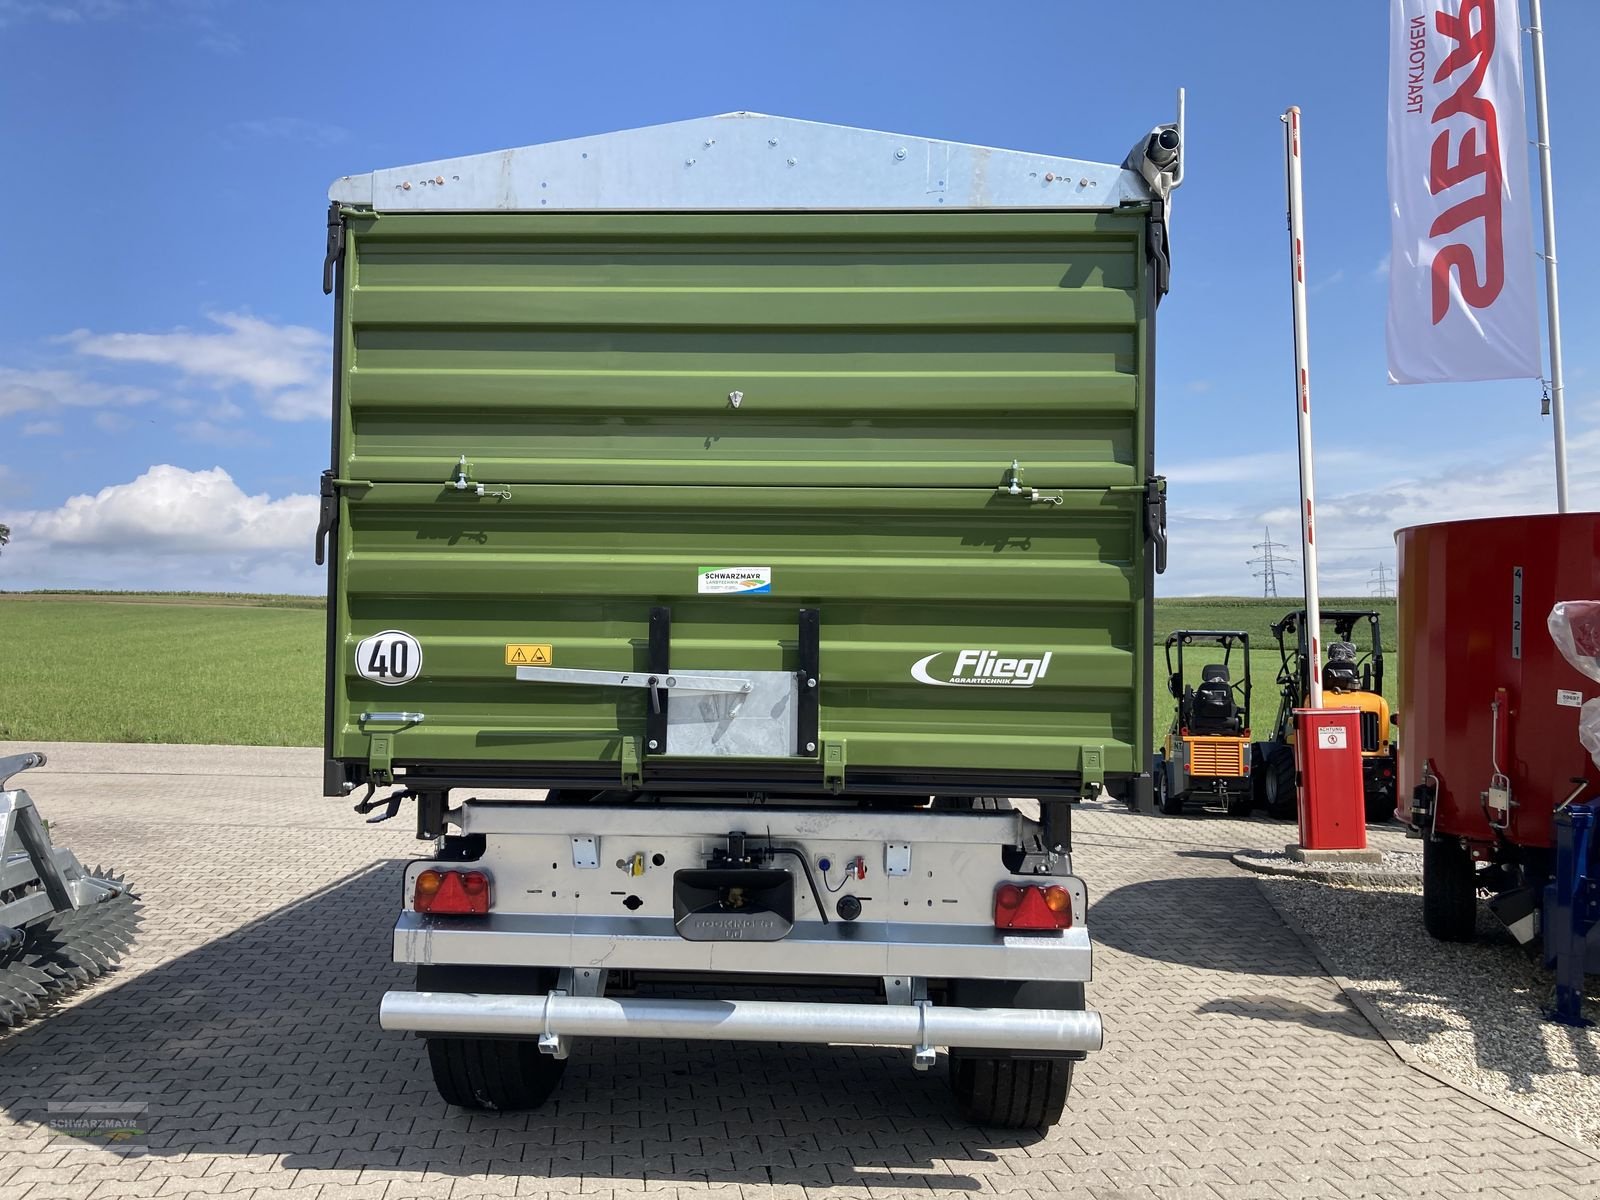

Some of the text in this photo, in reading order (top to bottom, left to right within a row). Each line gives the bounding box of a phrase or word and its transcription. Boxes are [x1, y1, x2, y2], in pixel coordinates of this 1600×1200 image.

[1515, 569, 1521, 578] 4
[1514, 595, 1521, 604] 3
[1514, 621, 1520, 630] 2
[1514, 647, 1519, 655] 1
[368, 640, 408, 677] 40
[952, 650, 1052, 684] Fliegl
